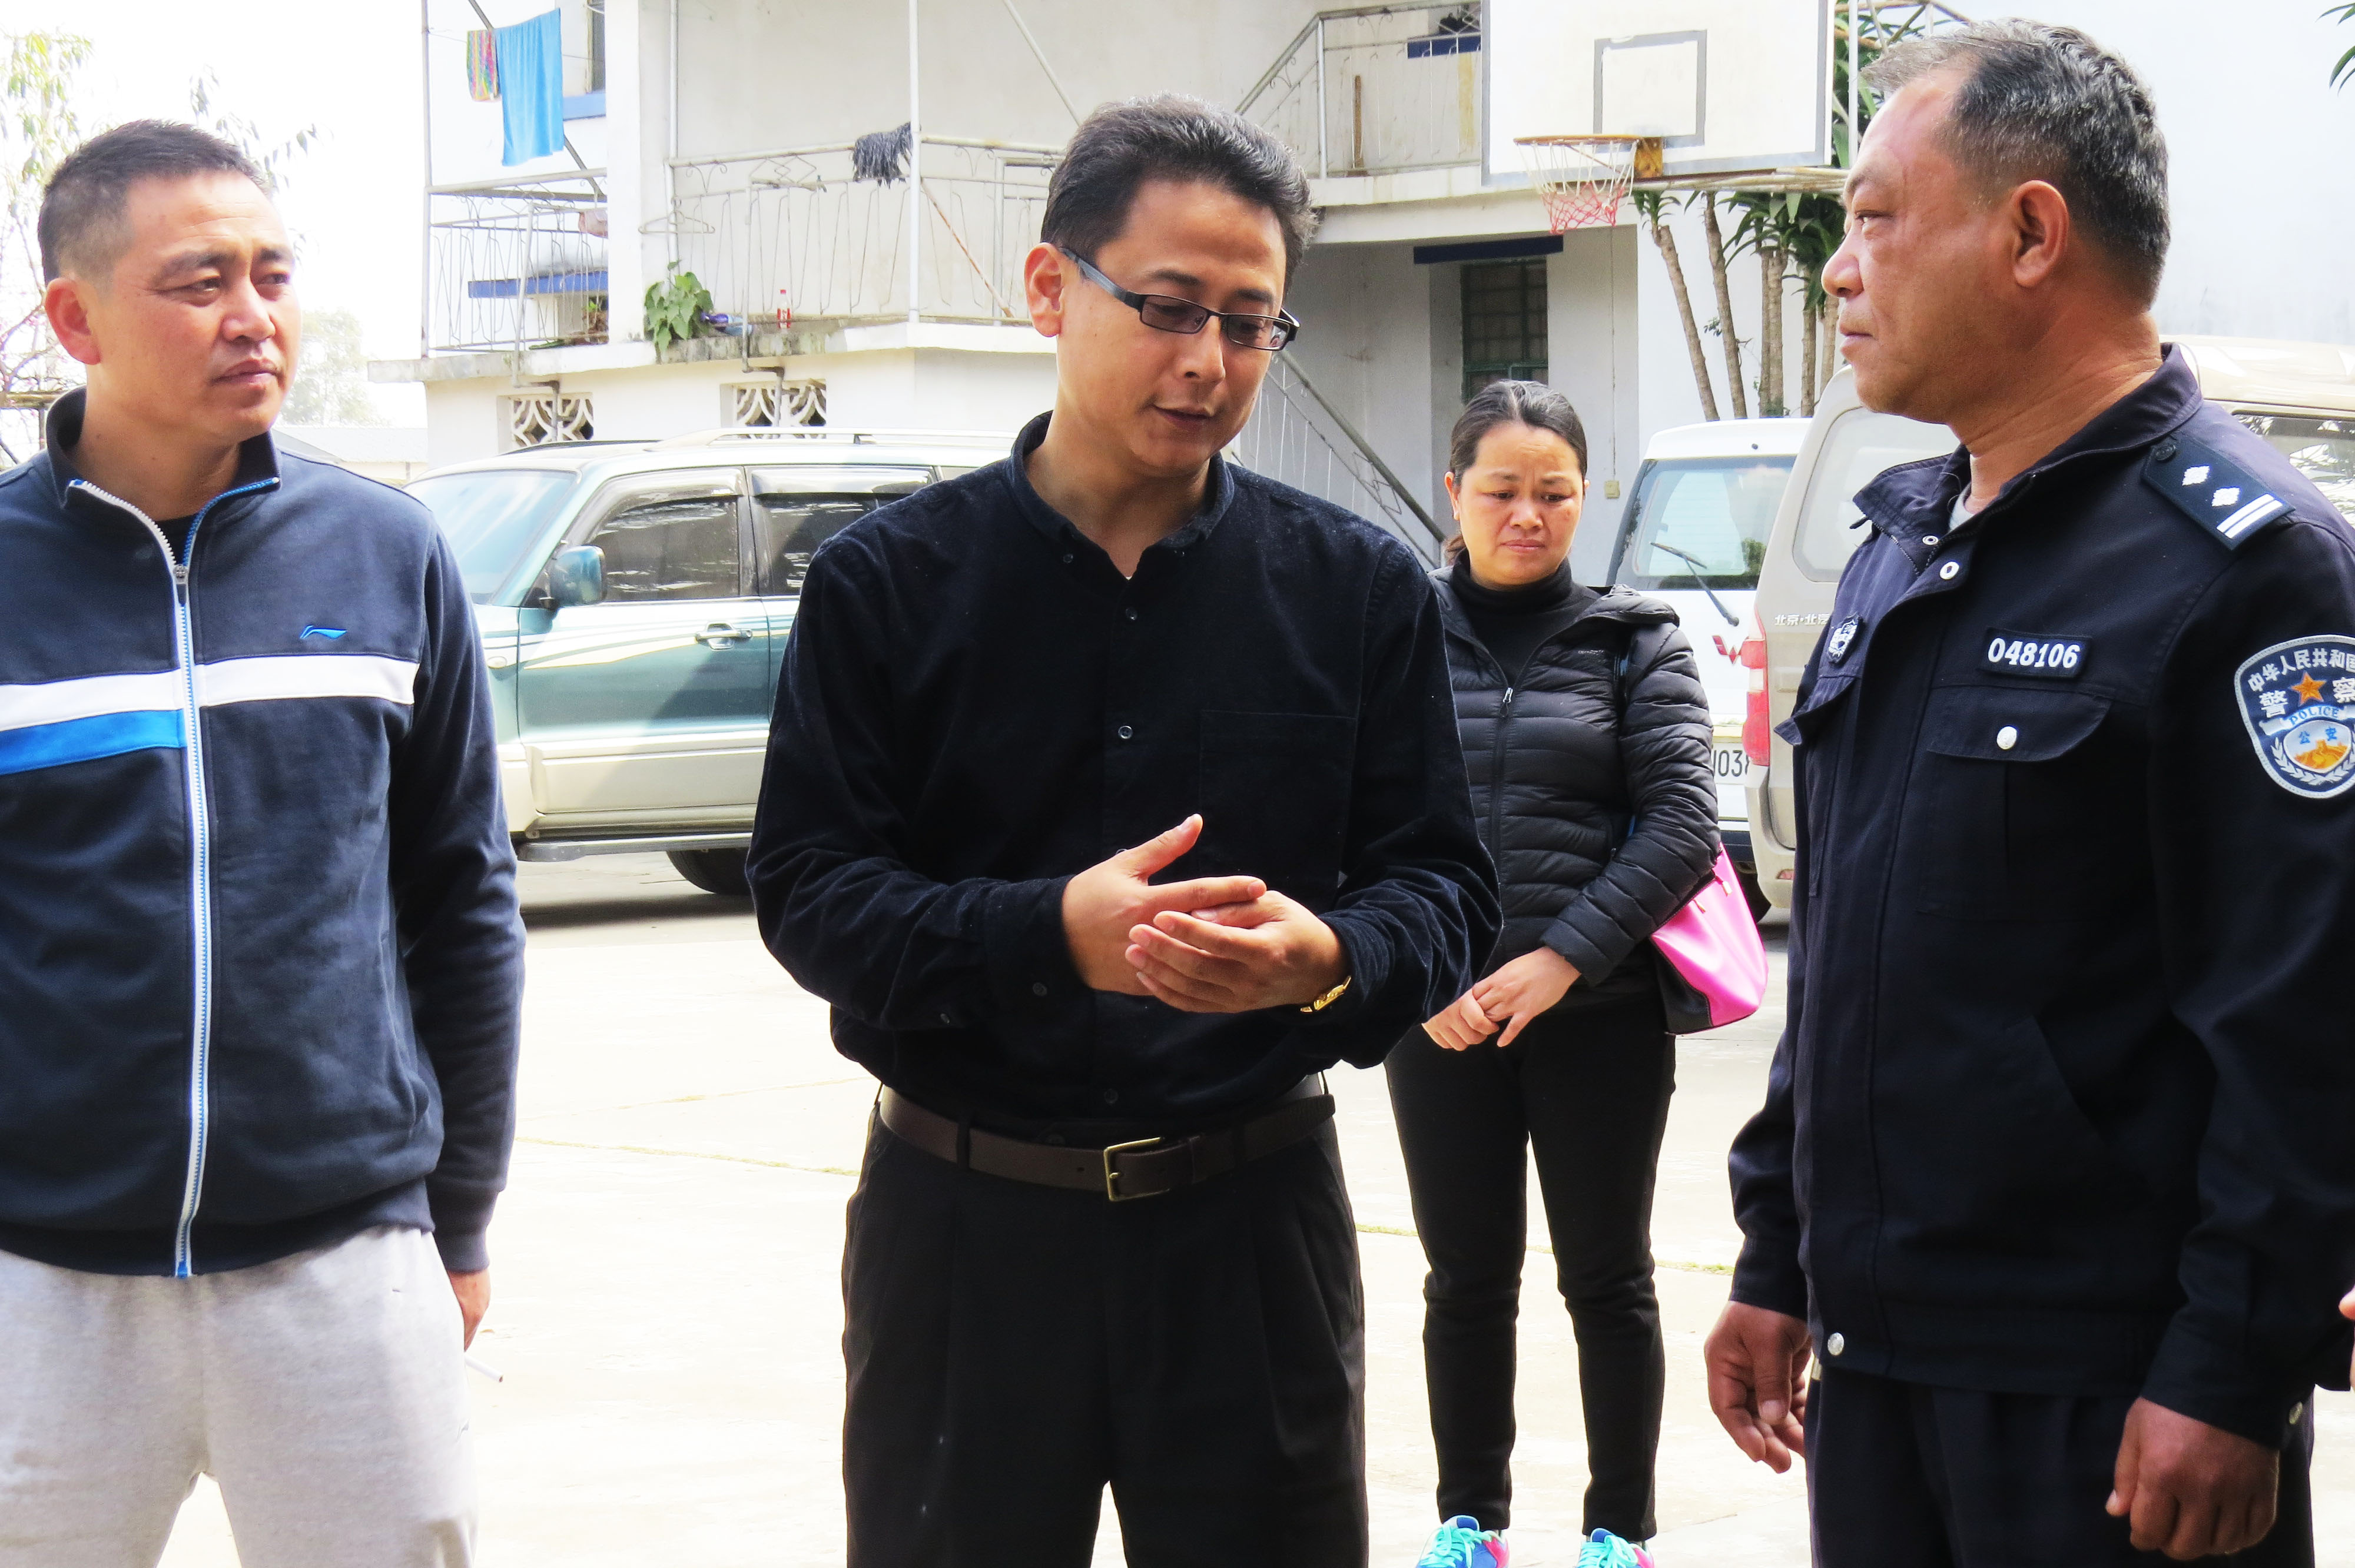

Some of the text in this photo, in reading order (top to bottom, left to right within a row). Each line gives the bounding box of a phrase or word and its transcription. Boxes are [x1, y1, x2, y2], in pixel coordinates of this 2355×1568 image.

[1988, 637, 2080, 668] 048106
[2248, 647, 2355, 692] 中华人民共和国
[2289, 706, 2339, 725] POLICE
